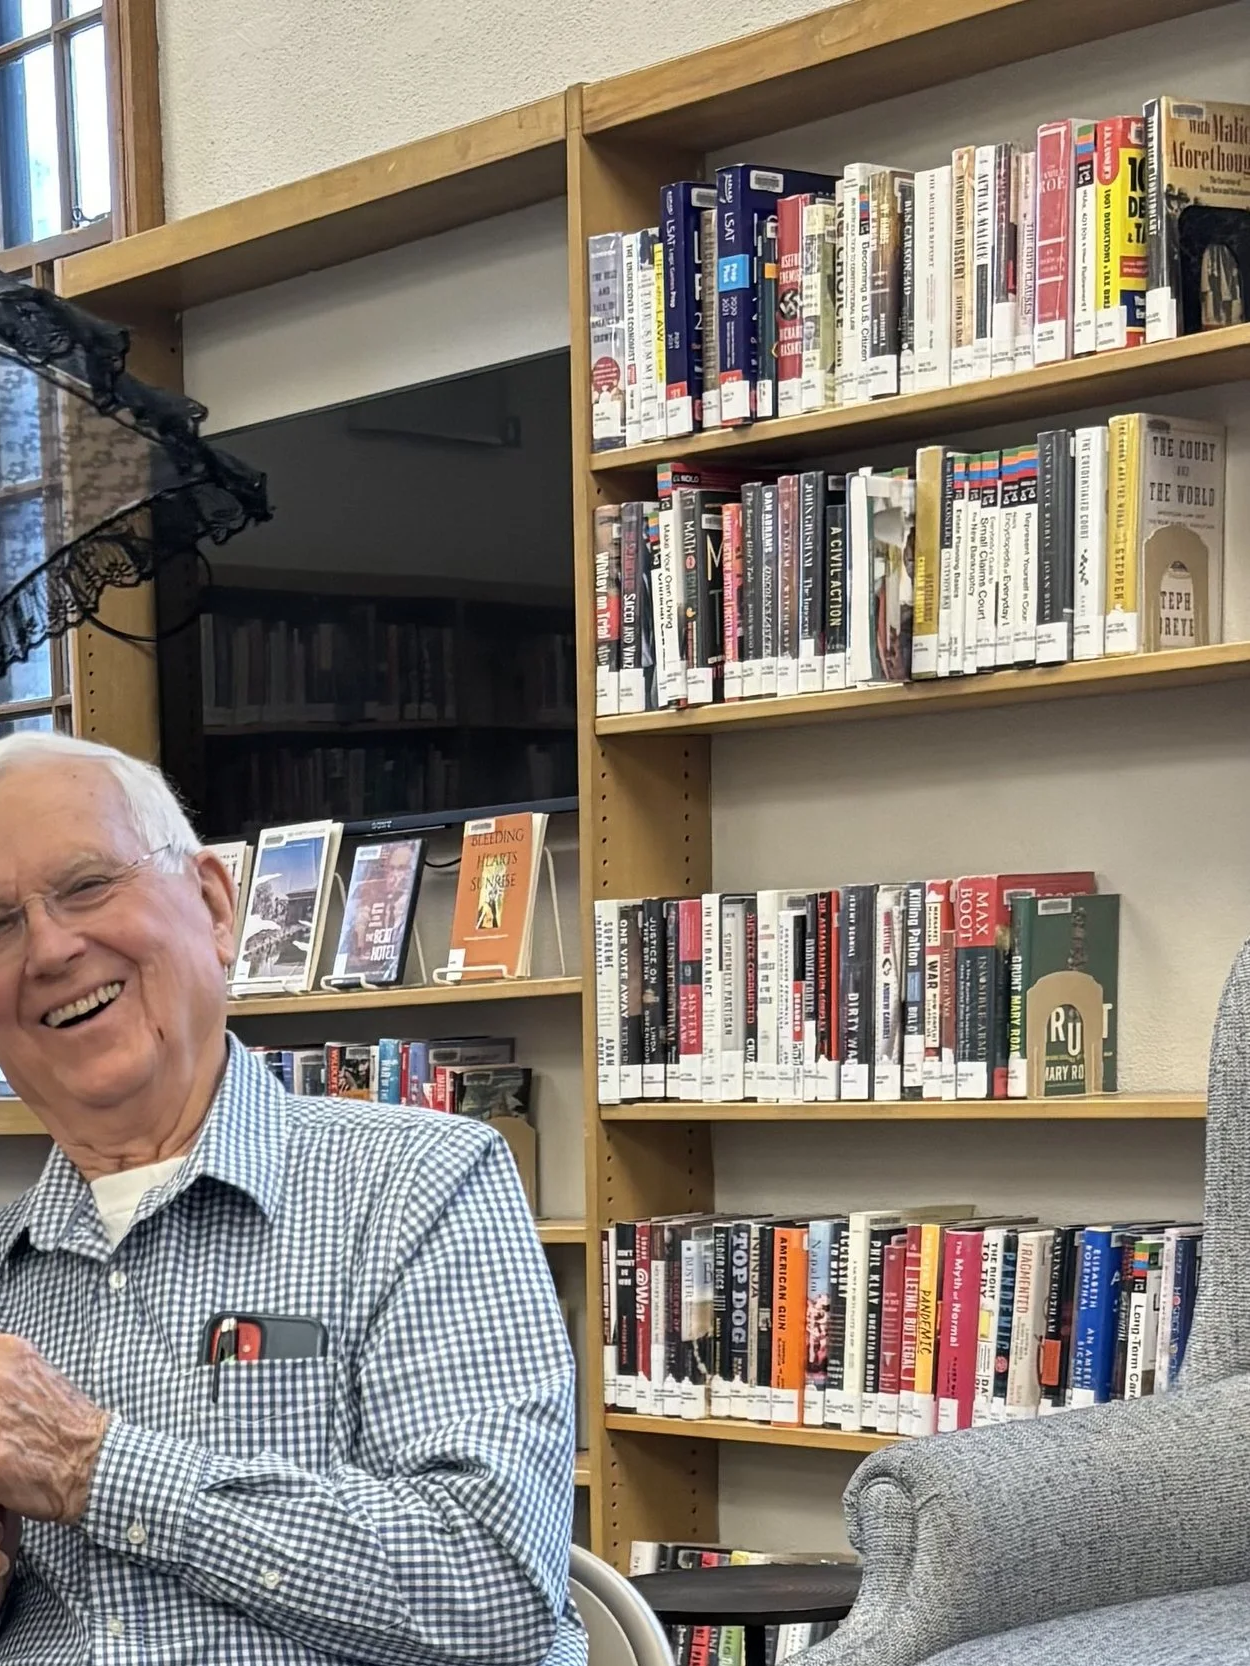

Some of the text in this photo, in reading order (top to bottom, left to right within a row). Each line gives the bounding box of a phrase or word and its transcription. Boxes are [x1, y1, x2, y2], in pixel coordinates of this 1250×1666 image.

[1170, 141, 1250, 175] Aforethoug
[666, 219, 676, 246] LSAT
[724, 212, 734, 243] LSAT
[860, 242, 869, 293] Becoming
[656, 310, 664, 342] LAW
[861, 328, 869, 362] Citizen
[1152, 436, 1216, 462] THE COURT
[1177, 485, 1215, 507] WORLD
[683, 521, 695, 553] MATH
[829, 526, 842, 626] A CIVIL ACTION
[977, 517, 988, 620] Small Claims Court
[623, 593, 635, 623] SACCO
[1000, 575, 1011, 620] Everyday
[471, 828, 524, 846] BLEEDING
[477, 851, 518, 869] HEARTS
[907, 888, 921, 926] Killing
[960, 888, 972, 942] BOOT
[976, 892, 988, 936] MAX
[604, 922, 614, 968] SUPREME
[620, 919, 628, 944] ONE
[649, 916, 657, 984] JUSTICE ON
[907, 929, 921, 966] Patton
[370, 945, 395, 961] HOTEL
[620, 948, 628, 980] VOTE
[704, 948, 712, 997] BALANCE
[926, 961, 938, 989] WAR
[1010, 956, 1021, 1026] GRUNT MARY
[724, 990, 732, 1035] PARTISAN
[847, 992, 859, 1032] DIRTY
[778, 1237, 787, 1300] AMERICAN
[870, 1241, 881, 1267] PHIL
[953, 1258, 963, 1289] Myth
[988, 1242, 998, 1301] THE RIGHT
[636, 1268, 649, 1323] @War
[684, 1256, 694, 1298] BUSTER
[731, 1232, 748, 1344] TOP DOG
[868, 1275, 879, 1305] KLAY
[1016, 1243, 1033, 1314] FRAGMENTED
[1089, 1249, 1101, 1308] ELISABETH
[778, 1306, 786, 1330] GUN
[997, 1252, 1015, 1350] PANDEMIC
[902, 1278, 918, 1369] LETHAL BUT LEGAL
[919, 1290, 932, 1356] PANDEMIC
[949, 1303, 961, 1347] Normal
[1086, 1328, 1094, 1344] AN
[1130, 1304, 1144, 1369] Long-Term
